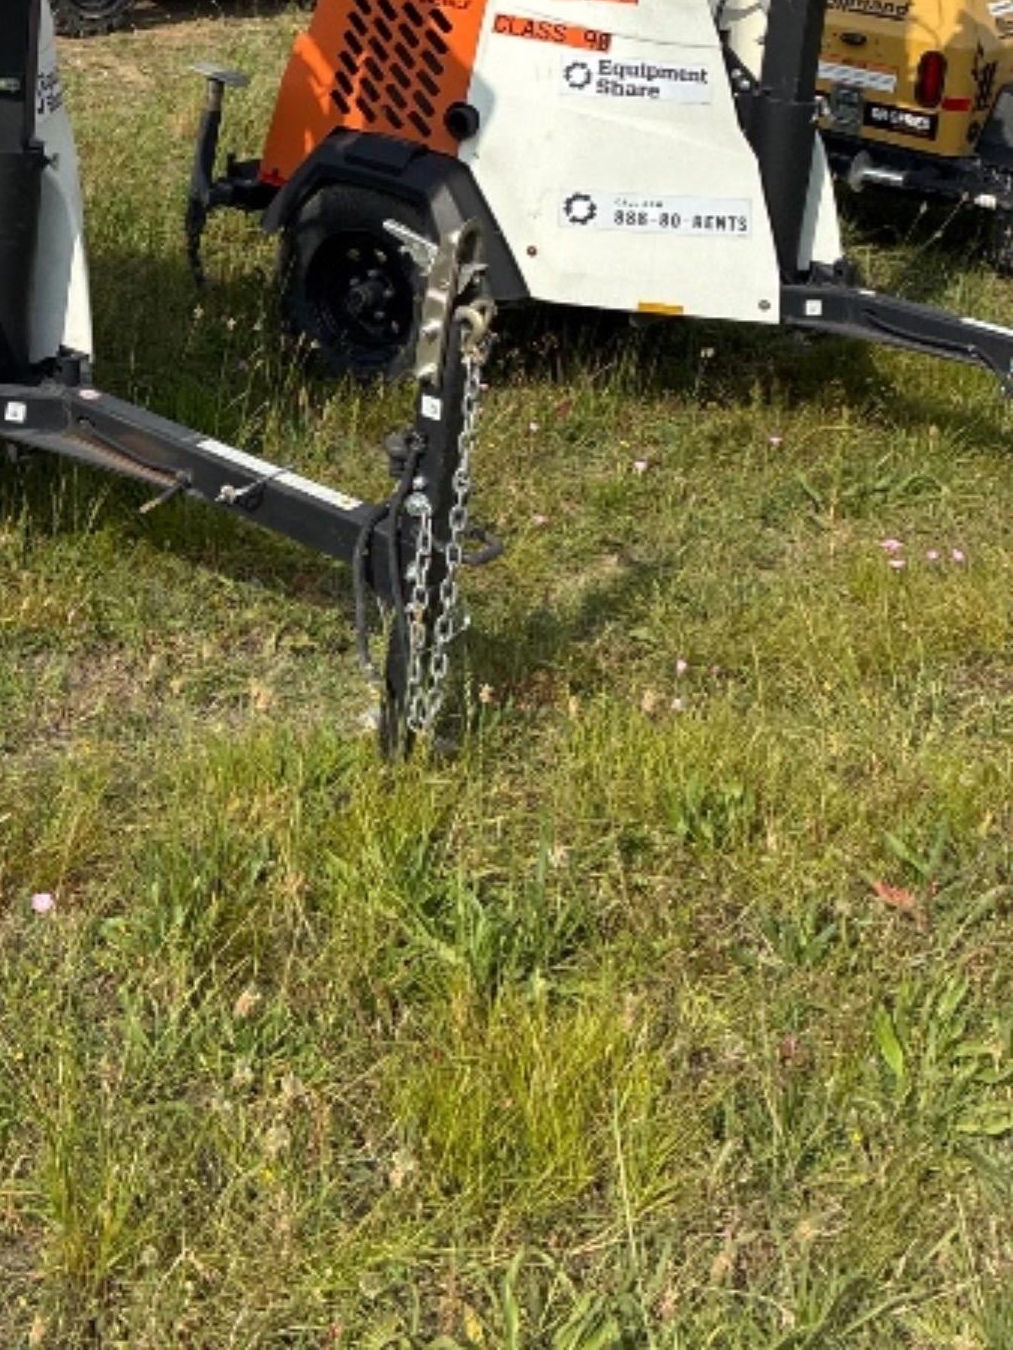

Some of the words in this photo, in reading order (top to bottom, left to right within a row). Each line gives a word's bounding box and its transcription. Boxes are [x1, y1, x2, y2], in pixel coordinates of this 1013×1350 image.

[493, 14, 568, 43] CLASS
[596, 59, 709, 84] Equipment
[596, 79, 661, 98] Share
